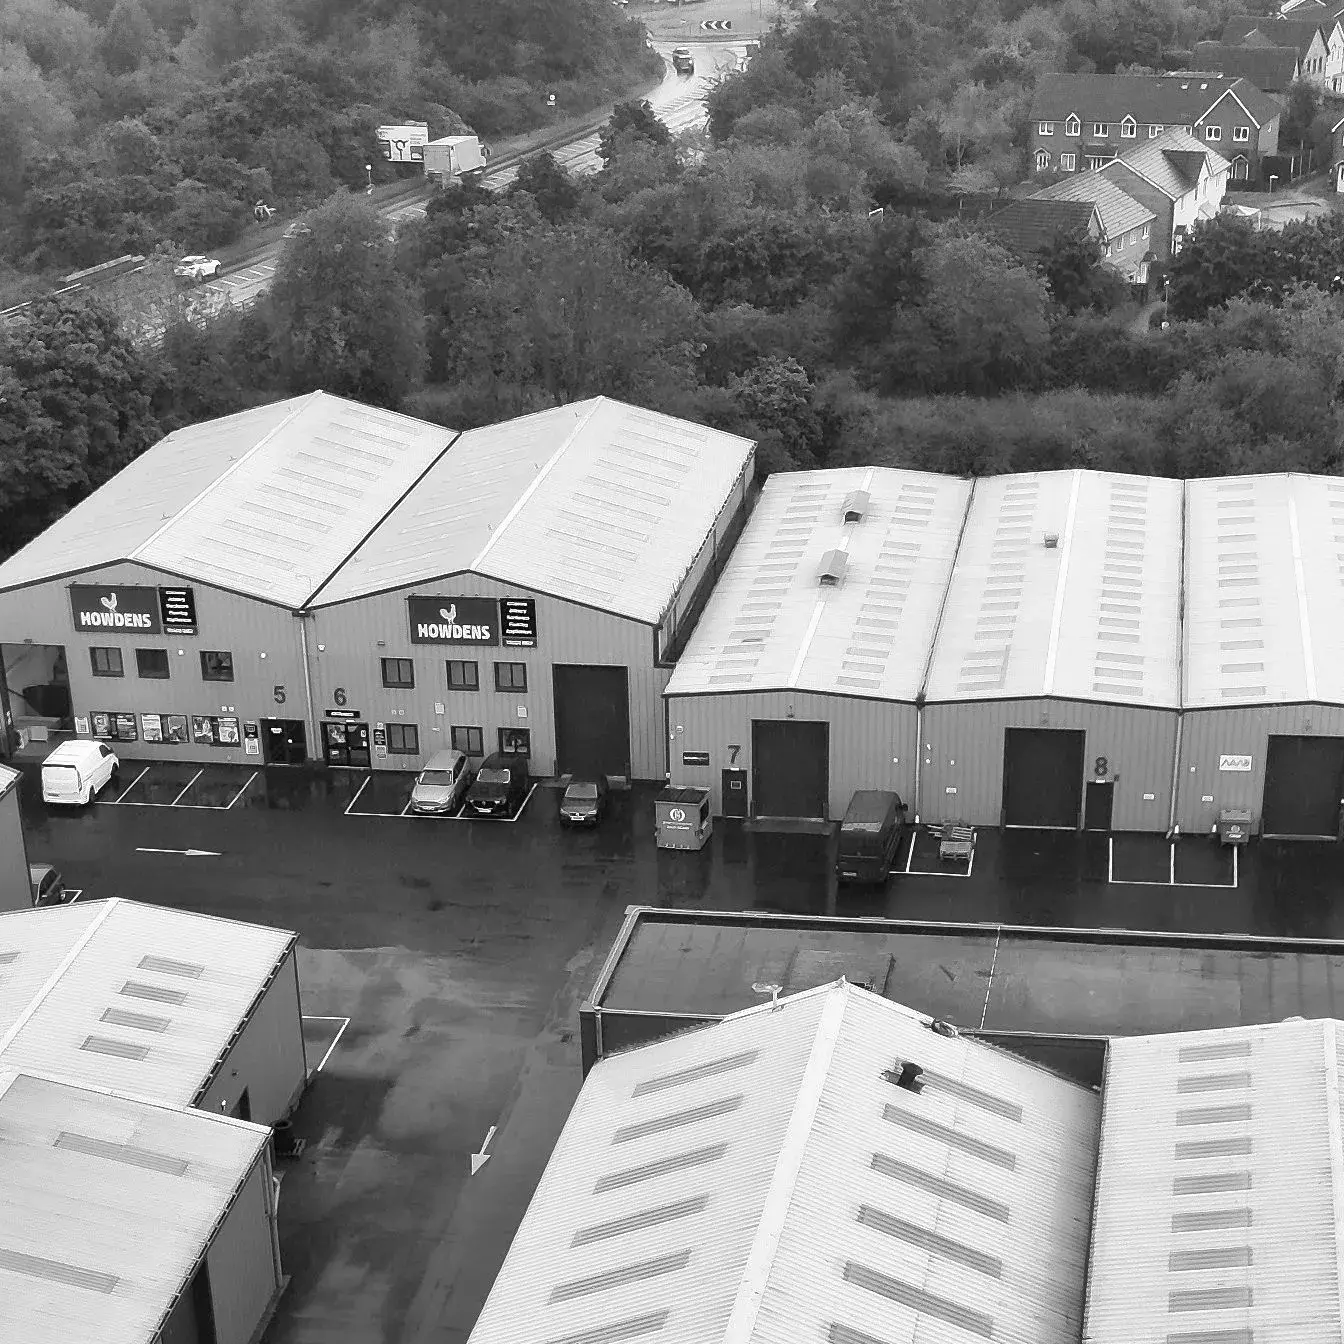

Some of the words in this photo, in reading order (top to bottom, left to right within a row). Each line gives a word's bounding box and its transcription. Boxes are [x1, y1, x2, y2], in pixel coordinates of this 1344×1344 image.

[80, 611, 152, 628] HOWDENS
[417, 623, 491, 640] HOWDENS
[274, 685, 286, 704] 5
[334, 687, 347, 706] 6
[727, 744, 742, 764] 7
[1095, 756, 1108, 776] 8
